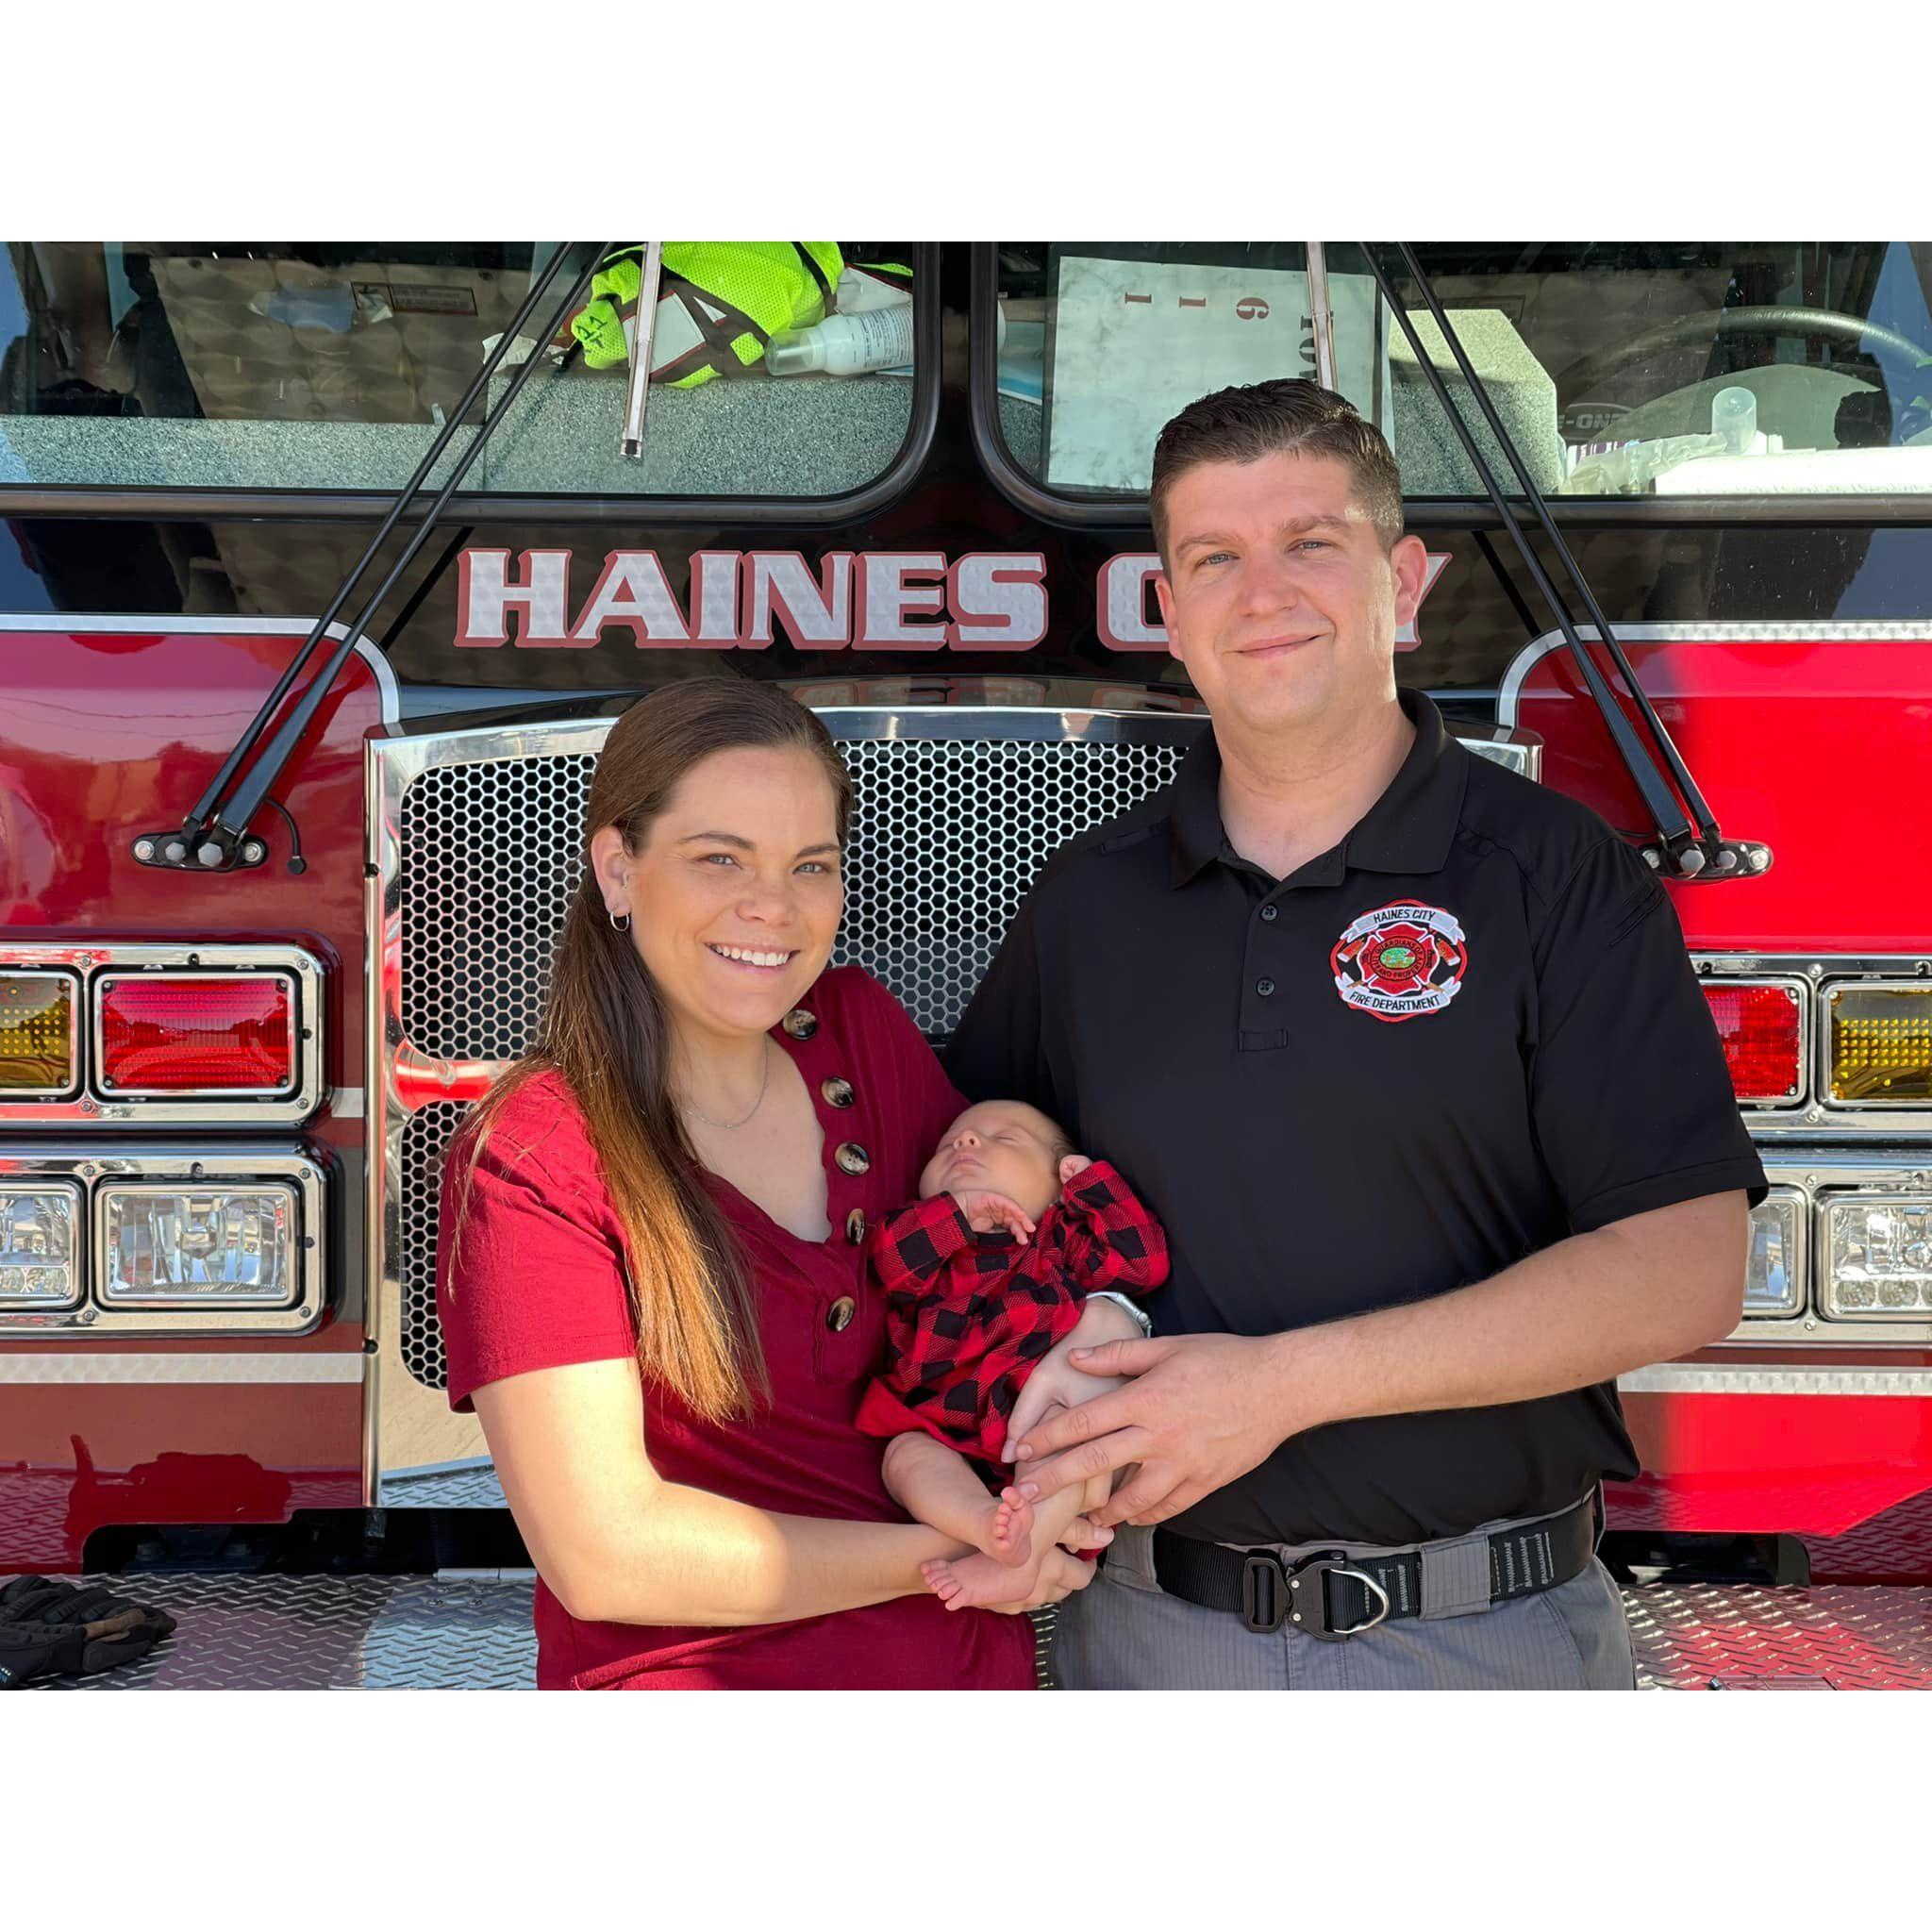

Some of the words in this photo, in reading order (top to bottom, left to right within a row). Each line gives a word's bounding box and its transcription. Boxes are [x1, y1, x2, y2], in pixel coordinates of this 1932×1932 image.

[1557, 414, 1623, 429] E-ON
[454, 548, 1048, 652] HAINES
[1374, 908, 1410, 924] HAINES
[1412, 909, 1436, 922] CITY
[1349, 991, 1372, 1006] FIRE
[1372, 995, 1441, 1011] DEPARTMENT
